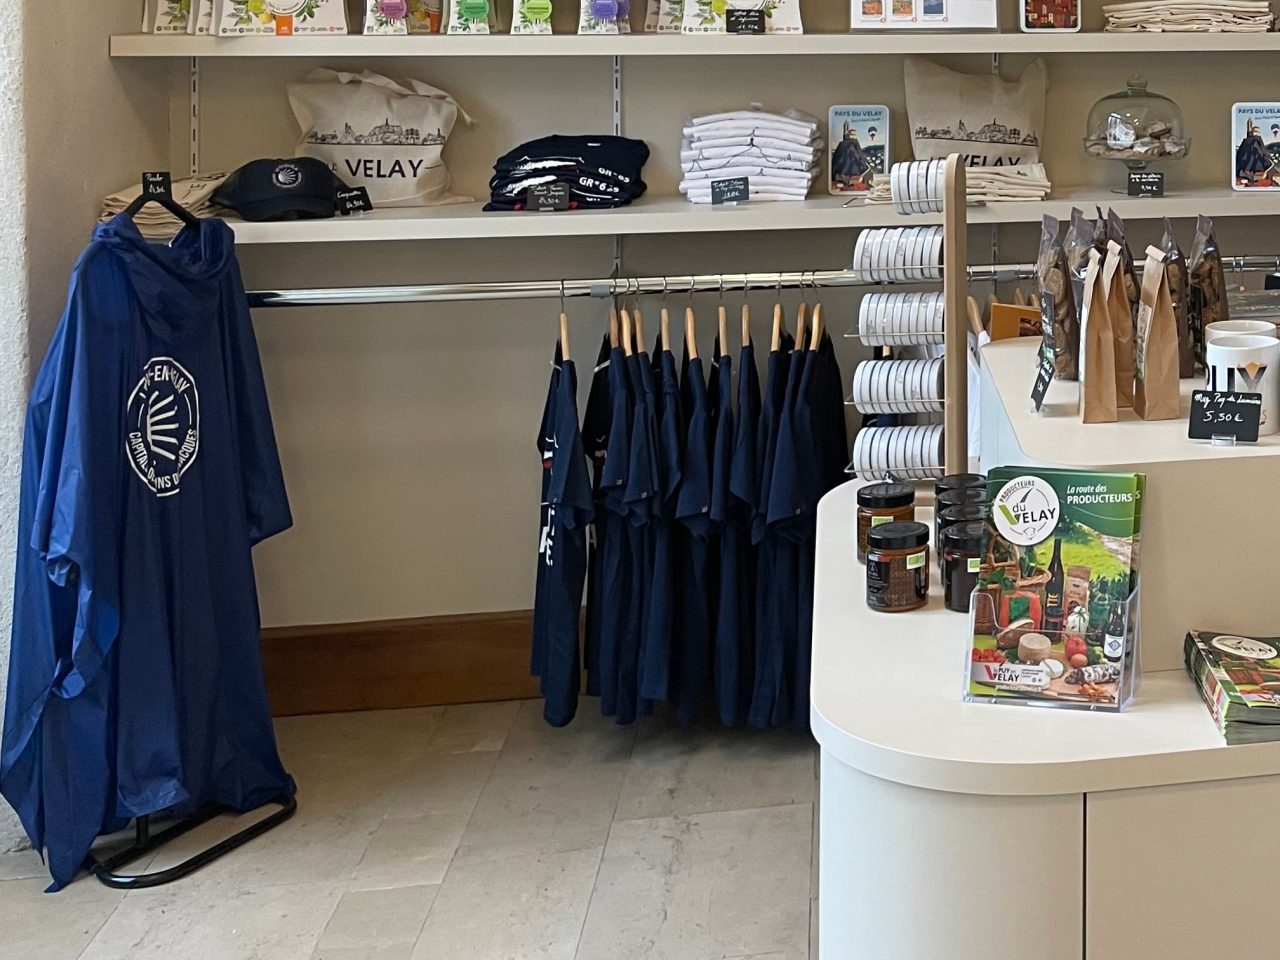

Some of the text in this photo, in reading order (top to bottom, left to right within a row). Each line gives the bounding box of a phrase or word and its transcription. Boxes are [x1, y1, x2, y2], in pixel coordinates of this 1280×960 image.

[345, 158, 424, 178] VELAY
[1000, 480, 1035, 502] PRODUCTEURS
[1067, 484, 1108, 494] La route des
[1067, 493, 1132, 504] PRODUCTEURS
[1012, 502, 1026, 513] du
